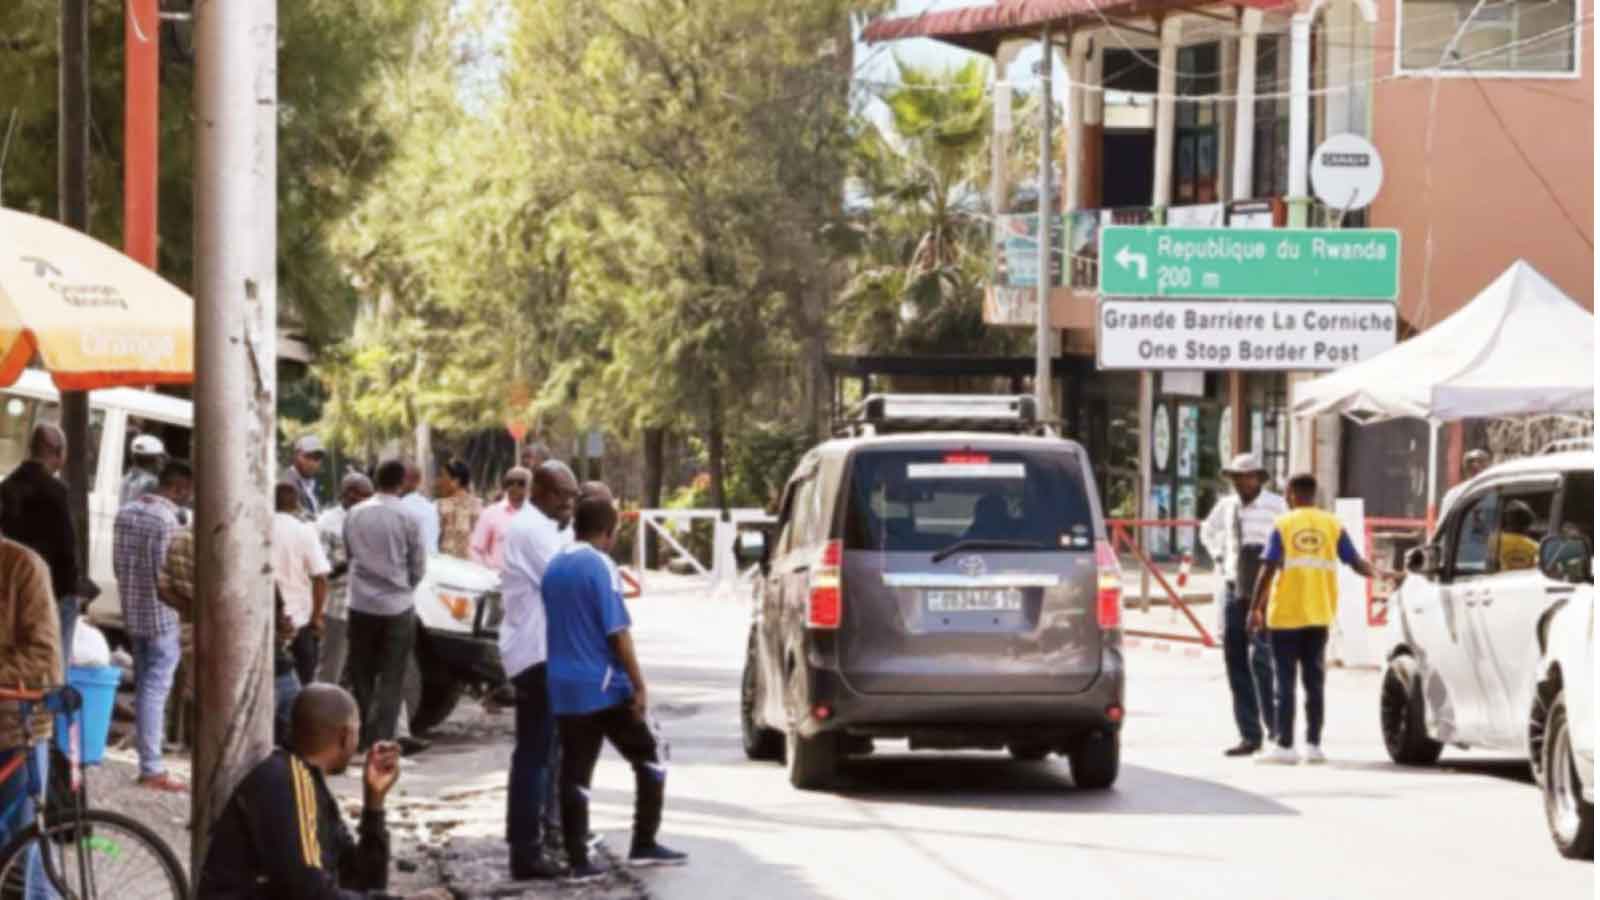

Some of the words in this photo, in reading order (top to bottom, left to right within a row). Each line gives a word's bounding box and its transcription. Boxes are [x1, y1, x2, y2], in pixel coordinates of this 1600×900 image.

[1157, 235, 1265, 264] Republique
[1277, 237, 1300, 259] du
[1312, 236, 1387, 260] Rwanda
[1158, 265, 1191, 288] 200
[1203, 271, 1221, 289] m
[1104, 309, 1177, 330] Grande
[1184, 308, 1265, 330] Barriere
[1272, 310, 1296, 331] La
[1303, 310, 1393, 331] Corniche
[1138, 340, 1178, 360] One
[1185, 340, 1232, 363] Stop
[1238, 340, 1308, 361] Border
[1313, 341, 1359, 362] Post
